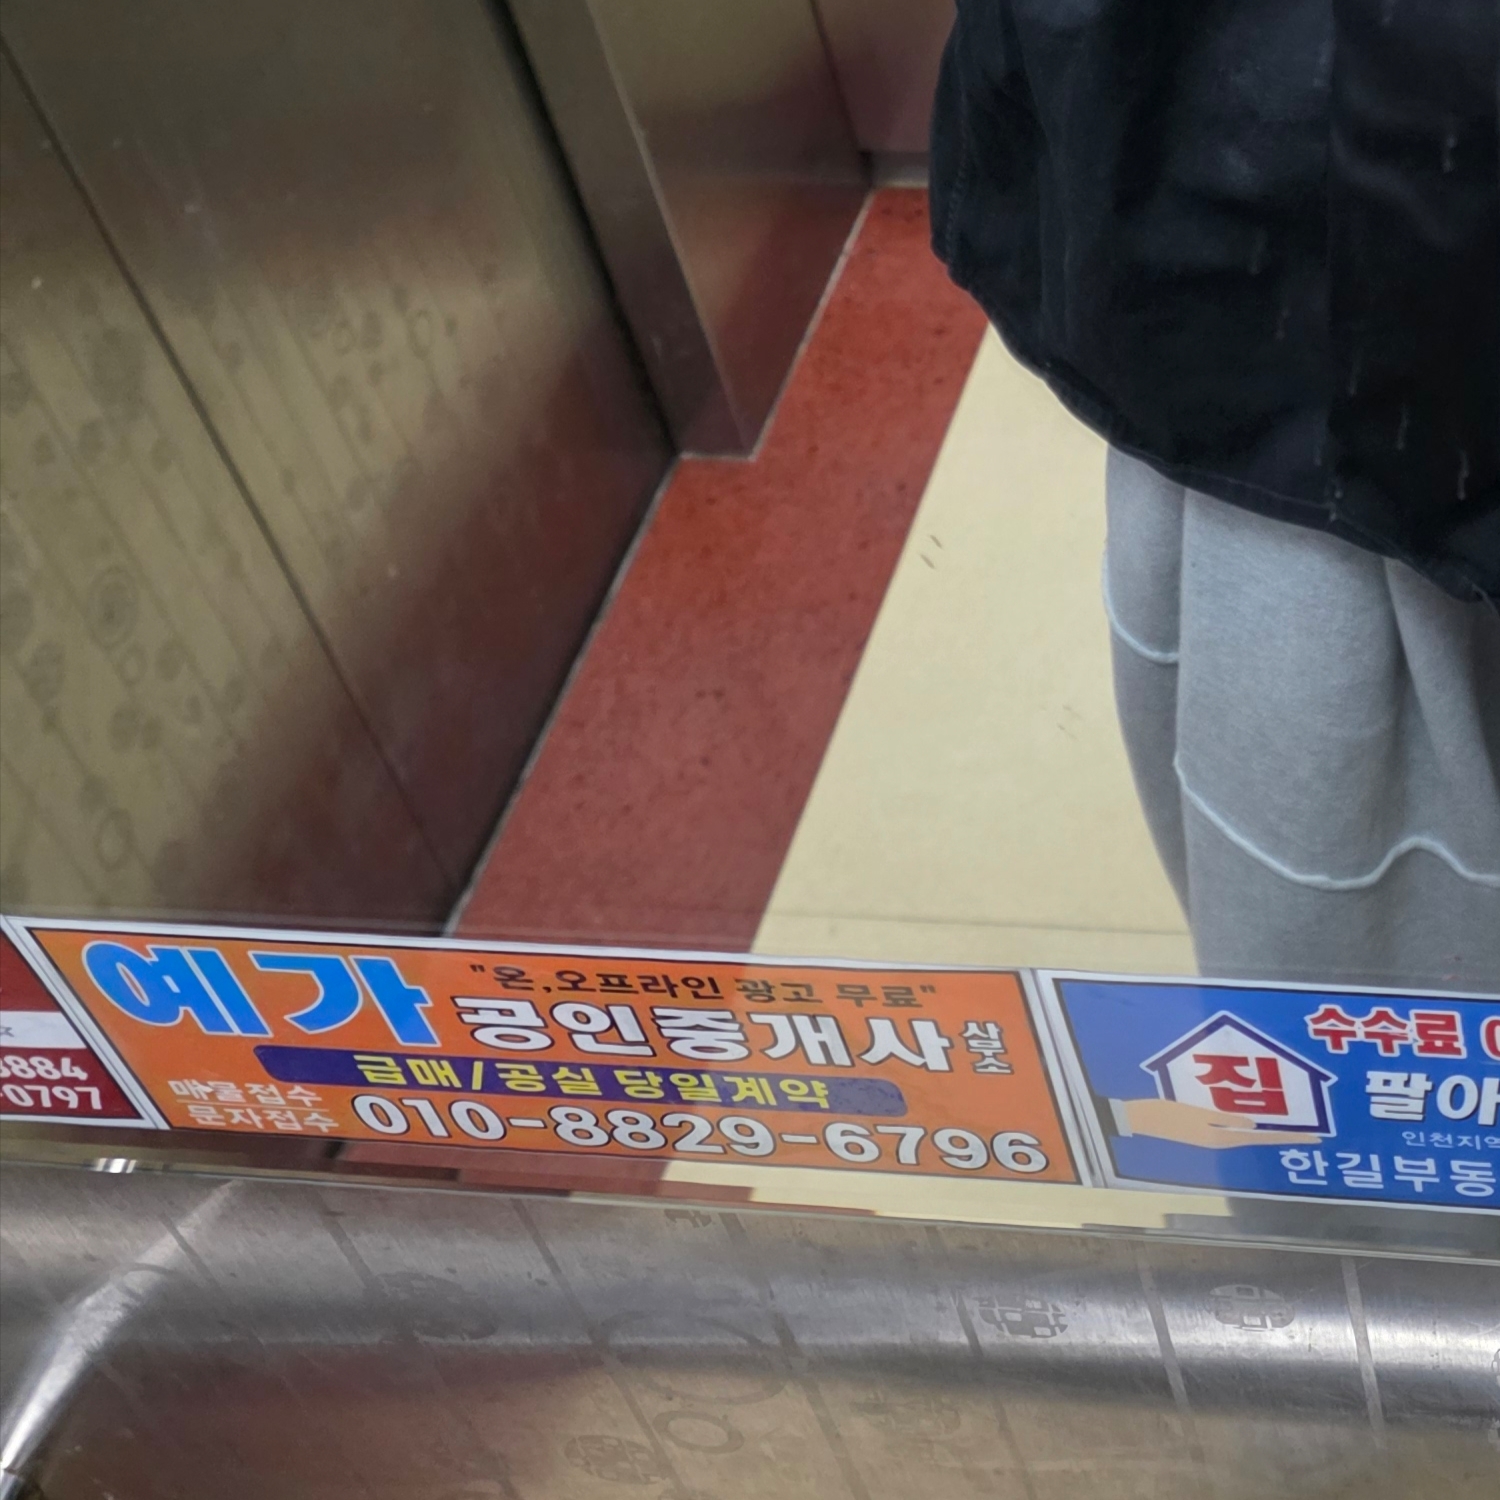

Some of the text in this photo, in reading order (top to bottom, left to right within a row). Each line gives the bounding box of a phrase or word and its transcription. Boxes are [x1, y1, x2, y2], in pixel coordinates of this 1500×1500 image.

[82, 940, 442, 1047] 예가
[735, 977, 823, 1004] 광고
[836, 983, 938, 1008] 무료"
[450, 995, 955, 1073] 공인중개사
[1305, 1004, 1467, 1059] 수수료
[612, 1068, 830, 1109] 당일계약
[1192, 1053, 1290, 1116] 집
[187, 1104, 340, 1133] 문자접수
[351, 1093, 1049, 1174] 010-8829-6796
